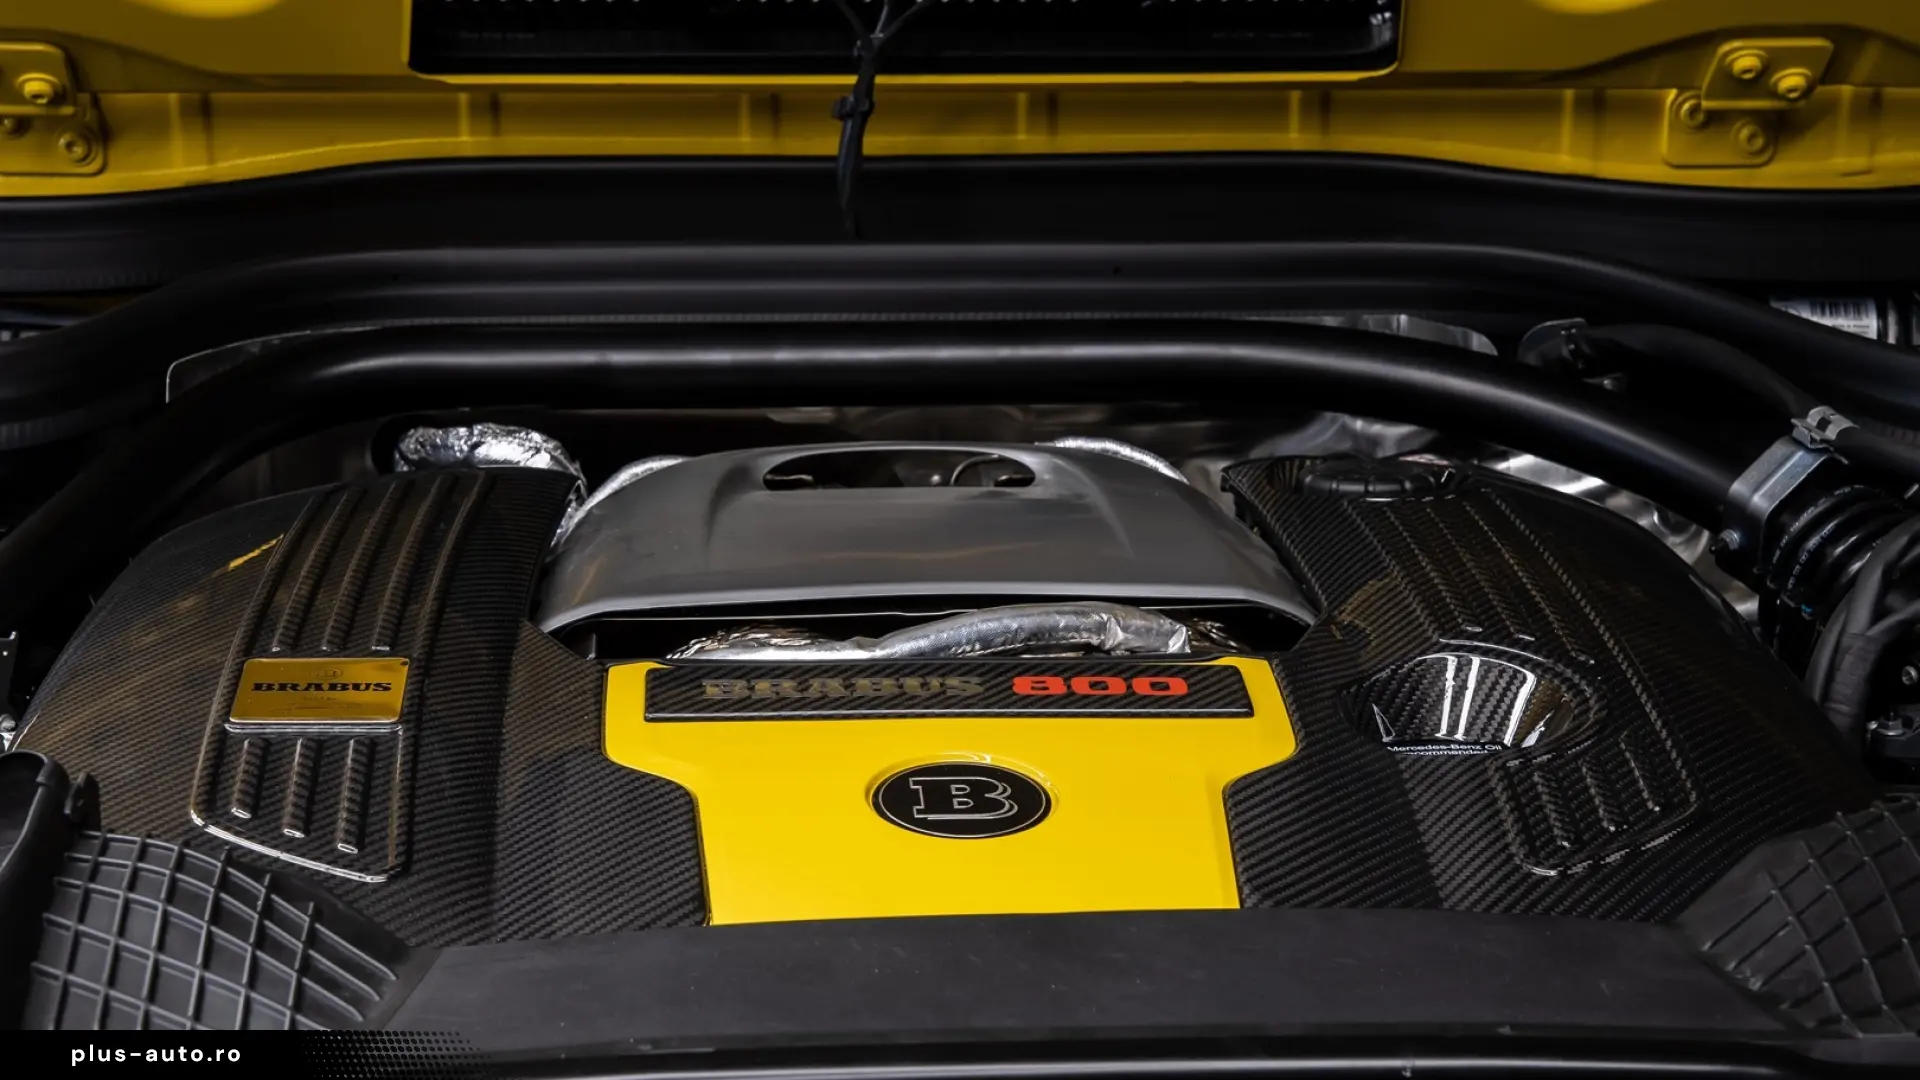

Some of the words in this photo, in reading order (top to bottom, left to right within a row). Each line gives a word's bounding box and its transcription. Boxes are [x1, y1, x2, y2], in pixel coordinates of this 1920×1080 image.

[251, 682, 392, 692] BRABUS
[702, 676, 985, 699] BRABUS
[1012, 676, 1188, 696] 800
[1387, 744, 1482, 752] Mercedes-Benz
[908, 775, 1019, 820] B
